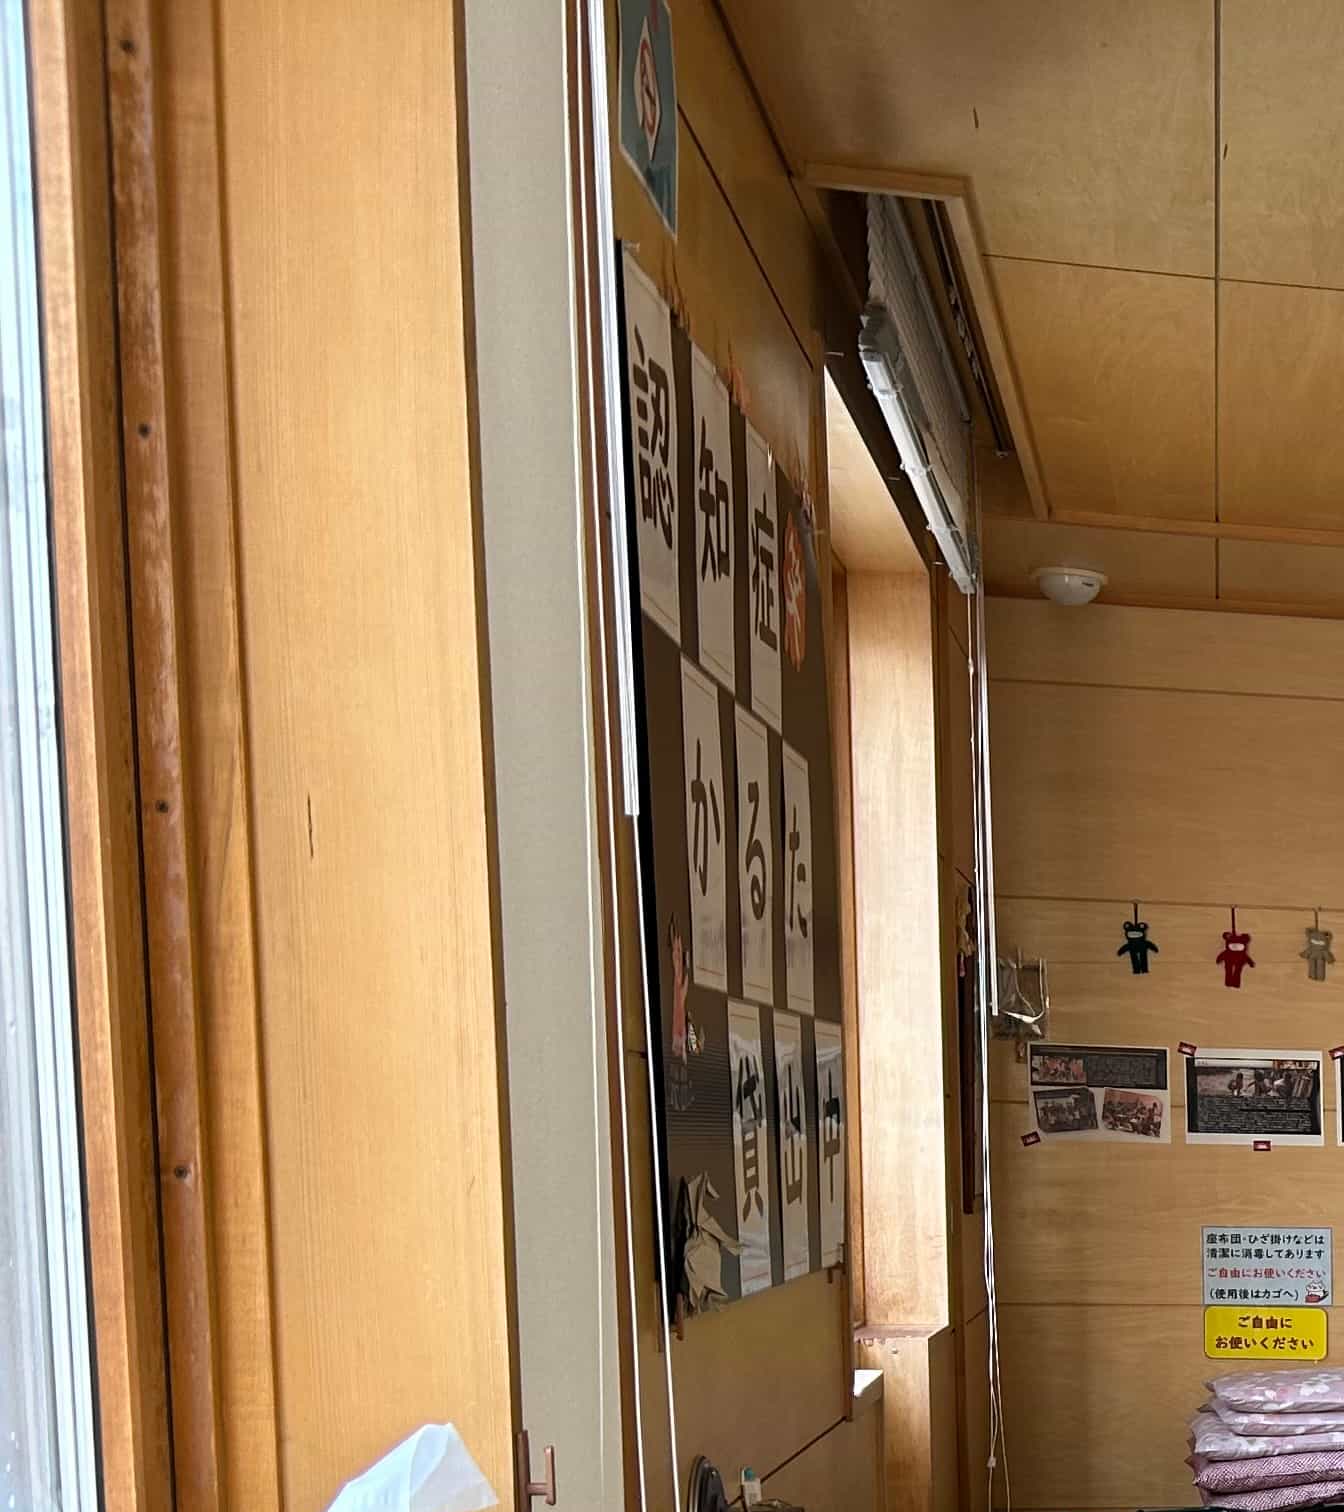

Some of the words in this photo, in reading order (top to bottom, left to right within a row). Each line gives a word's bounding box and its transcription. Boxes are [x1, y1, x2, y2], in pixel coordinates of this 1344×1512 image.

[632, 323, 778, 651] 認知症
[692, 739, 808, 938] かるた
[736, 1054, 841, 1222] 貸出中
[1206, 1233, 1325, 1245] 座布団・ひざ掛けなどは
[1206, 1248, 1325, 1259] 清潔に消毒してあります
[1207, 1267, 1326, 1279] ご自由にお使いください
[1209, 1288, 1299, 1301] (使用後はカゴへ)
[1238, 1315, 1293, 1329] ご自由に
[1215, 1336, 1314, 1350] お使いください
